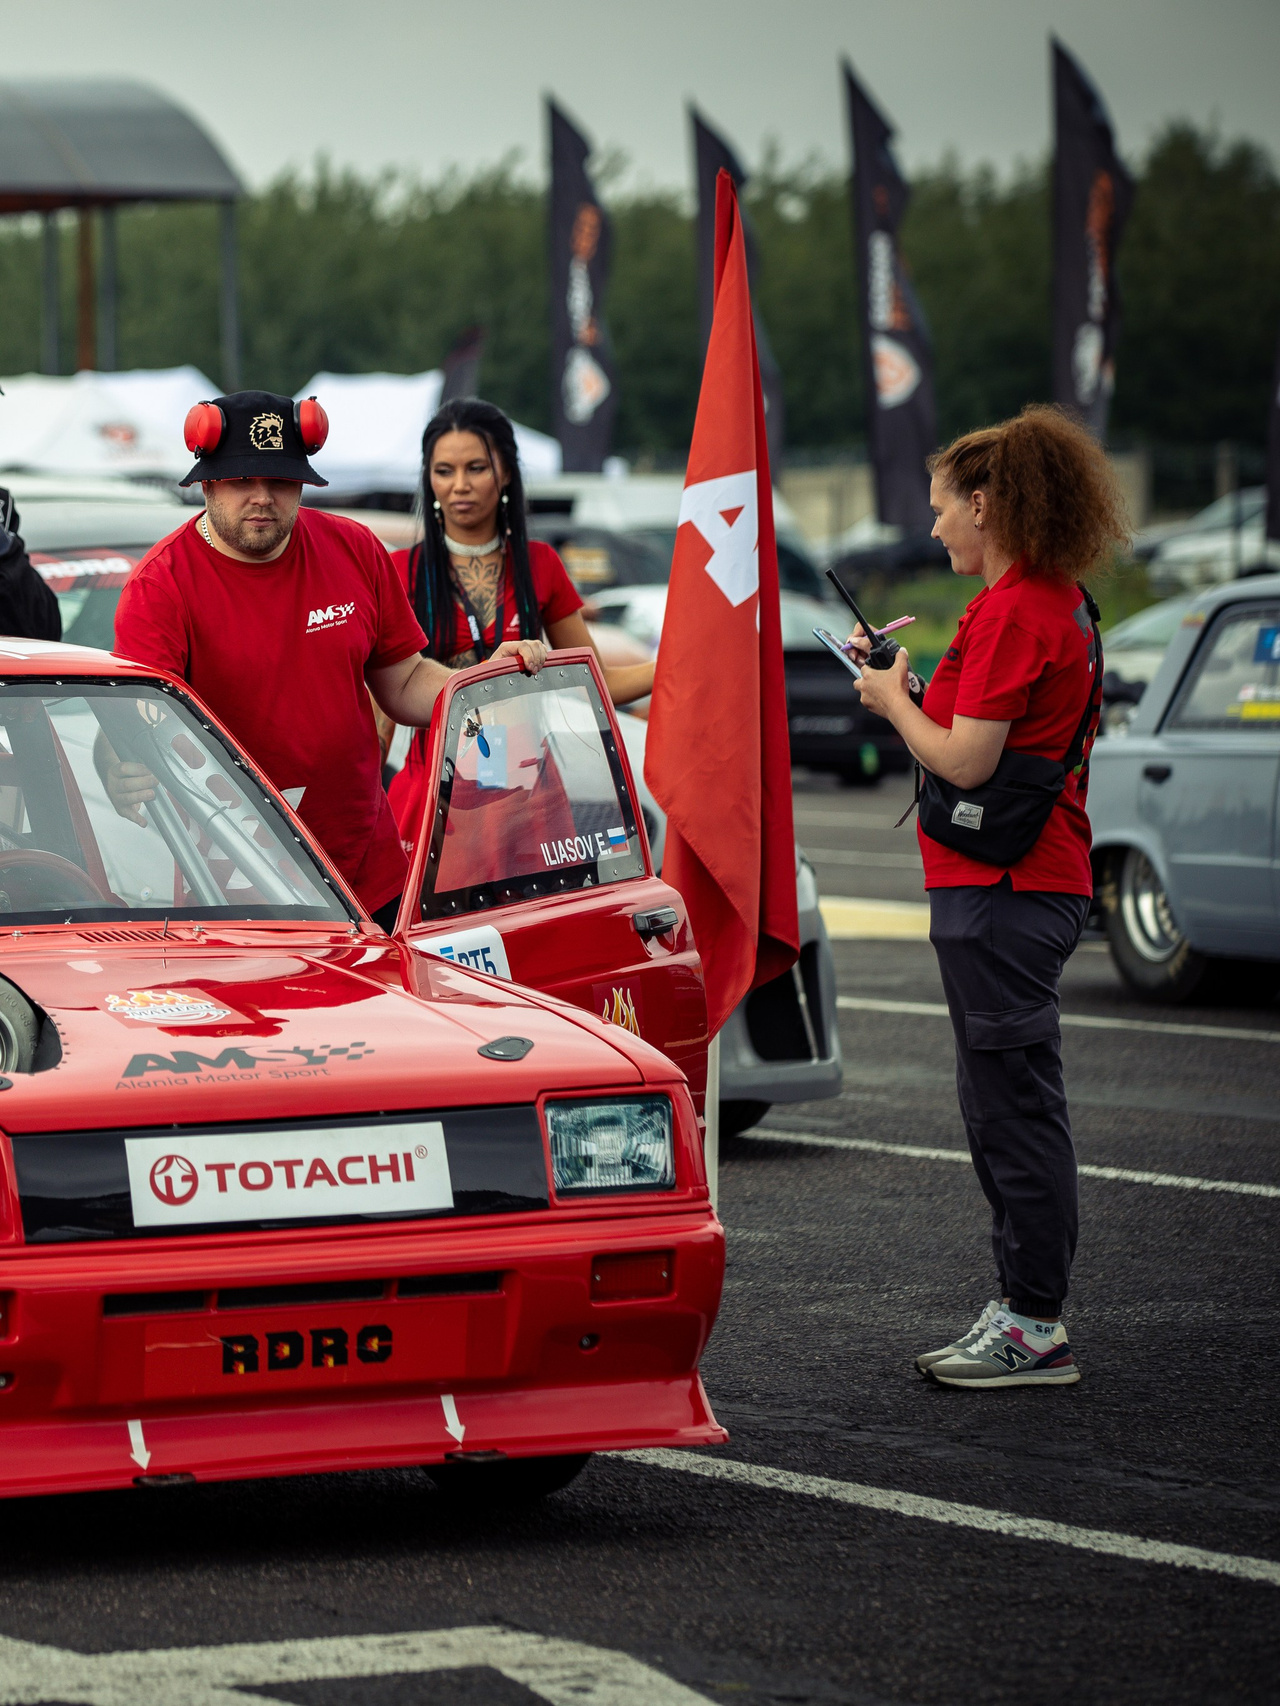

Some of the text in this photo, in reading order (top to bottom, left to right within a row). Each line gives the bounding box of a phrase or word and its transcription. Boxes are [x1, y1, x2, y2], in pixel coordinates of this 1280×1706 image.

[307, 604, 346, 627] AMS
[540, 835, 595, 867] ILIASOV
[121, 1045, 314, 1079] AMS
[115, 1067, 331, 1091] Alania Motor Sport
[221, 1325, 393, 1375] RDRC
